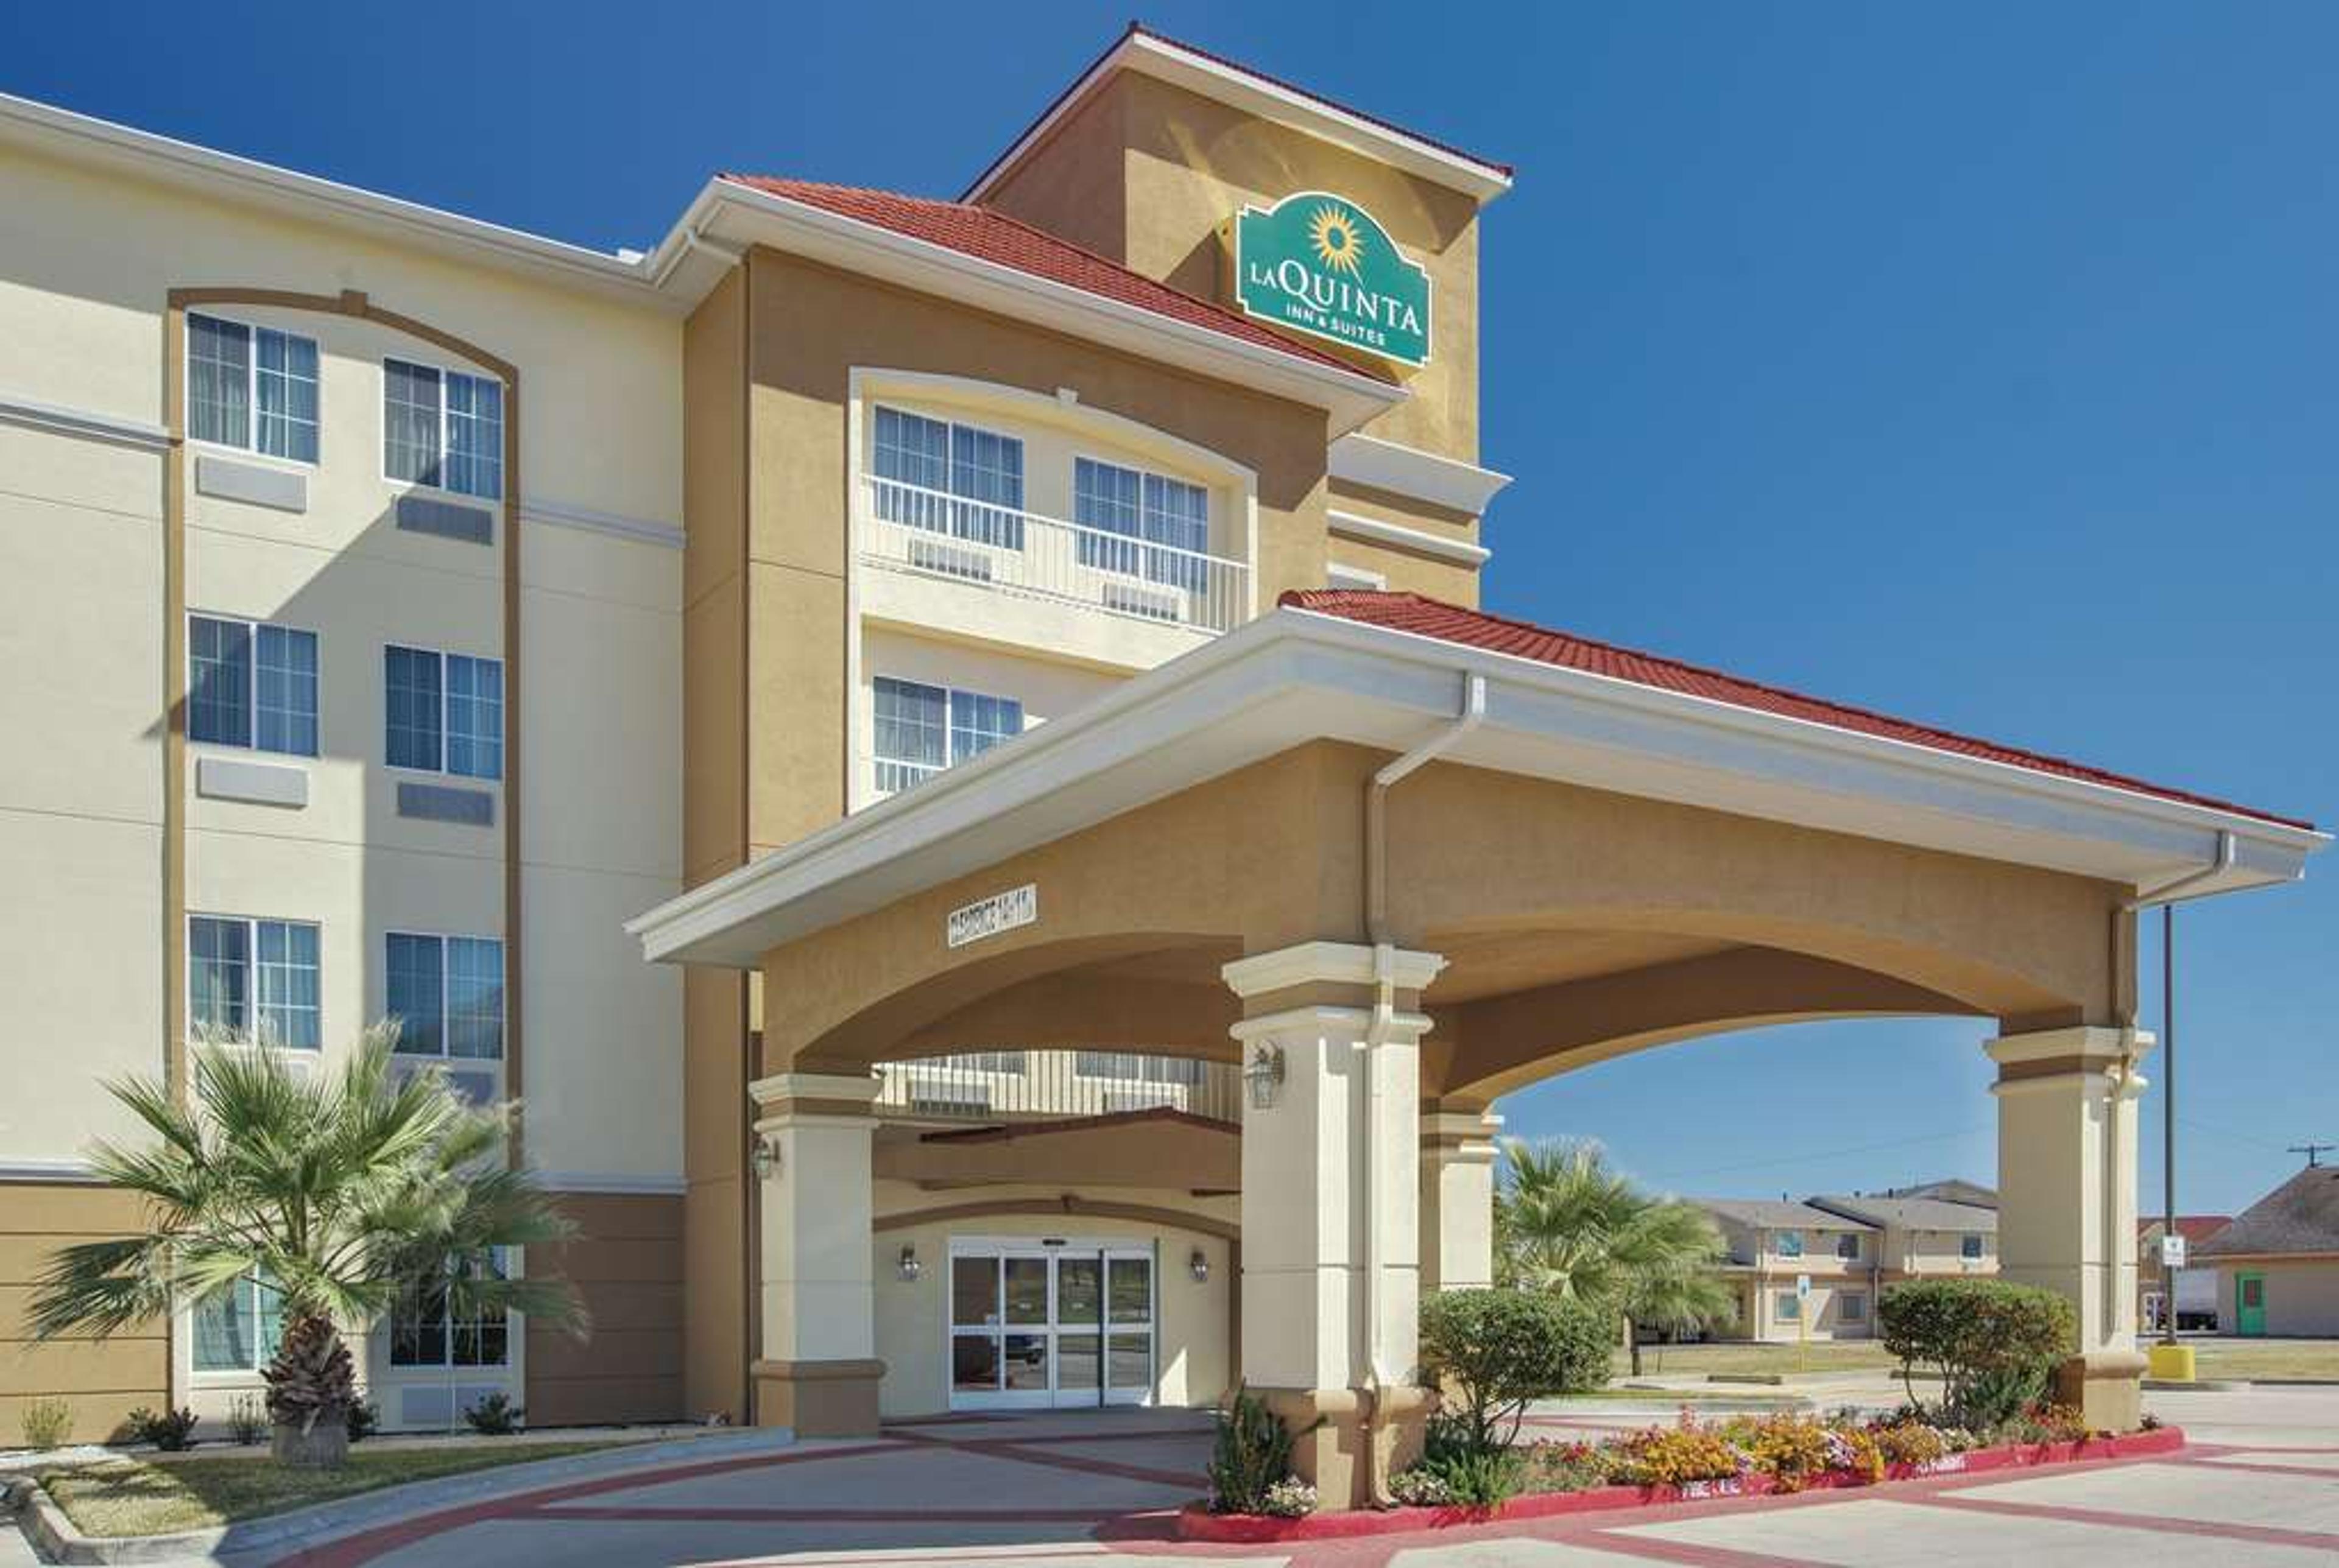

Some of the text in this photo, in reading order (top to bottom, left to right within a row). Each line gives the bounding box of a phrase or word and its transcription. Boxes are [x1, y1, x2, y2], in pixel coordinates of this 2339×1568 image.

[1251, 259, 1422, 335] LA QUINTA
[1286, 303, 1386, 346] INN & SUITES
